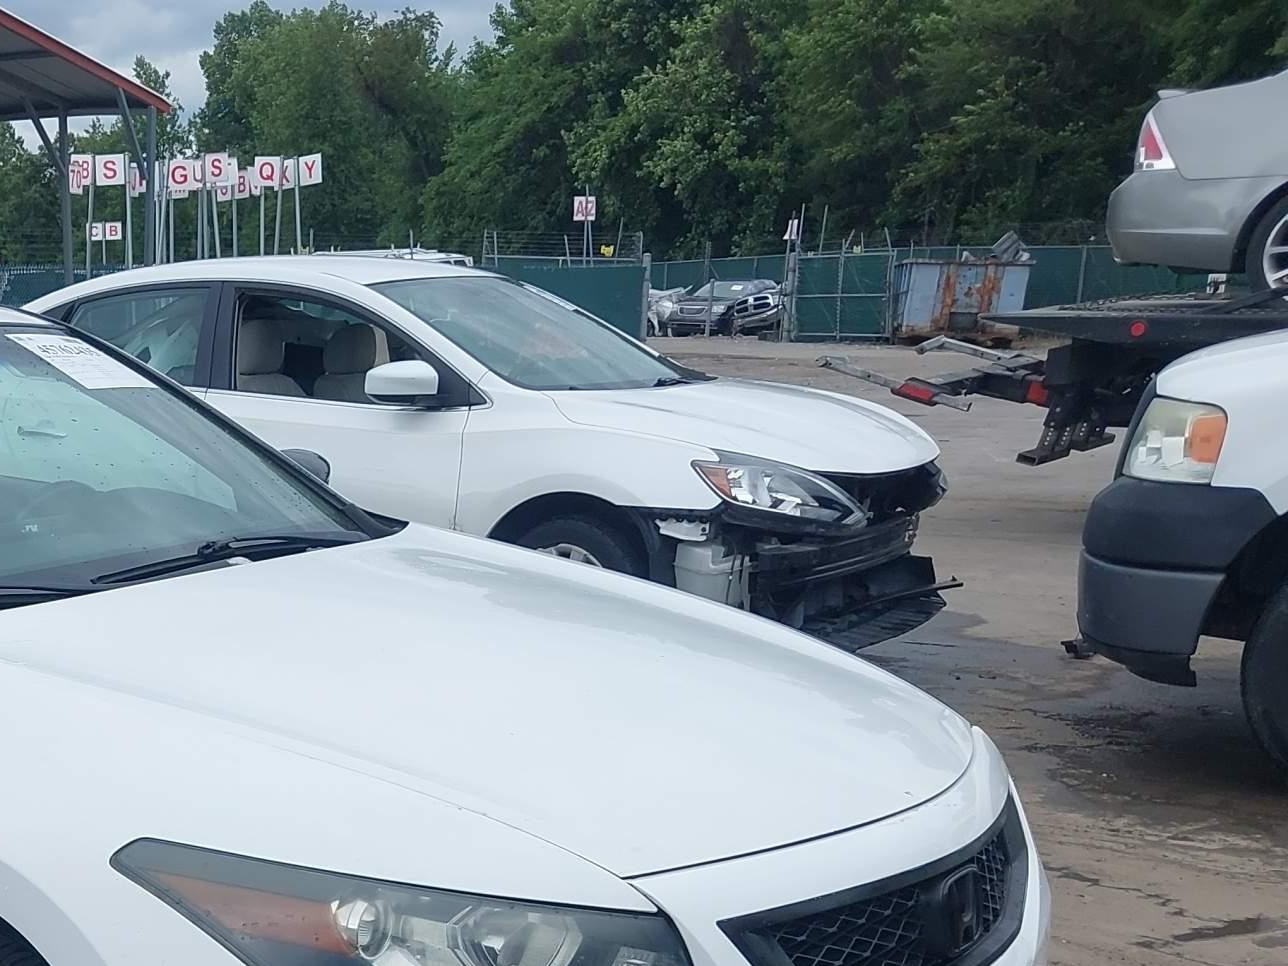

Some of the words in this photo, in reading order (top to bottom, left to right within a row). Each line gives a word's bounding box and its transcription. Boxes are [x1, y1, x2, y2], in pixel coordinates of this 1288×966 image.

[102, 160, 118, 180] S
[171, 165, 188, 185] G
[211, 158, 223, 177] S
[259, 161, 275, 182] Q
[304, 159, 316, 179] Y
[109, 225, 118, 237] B
